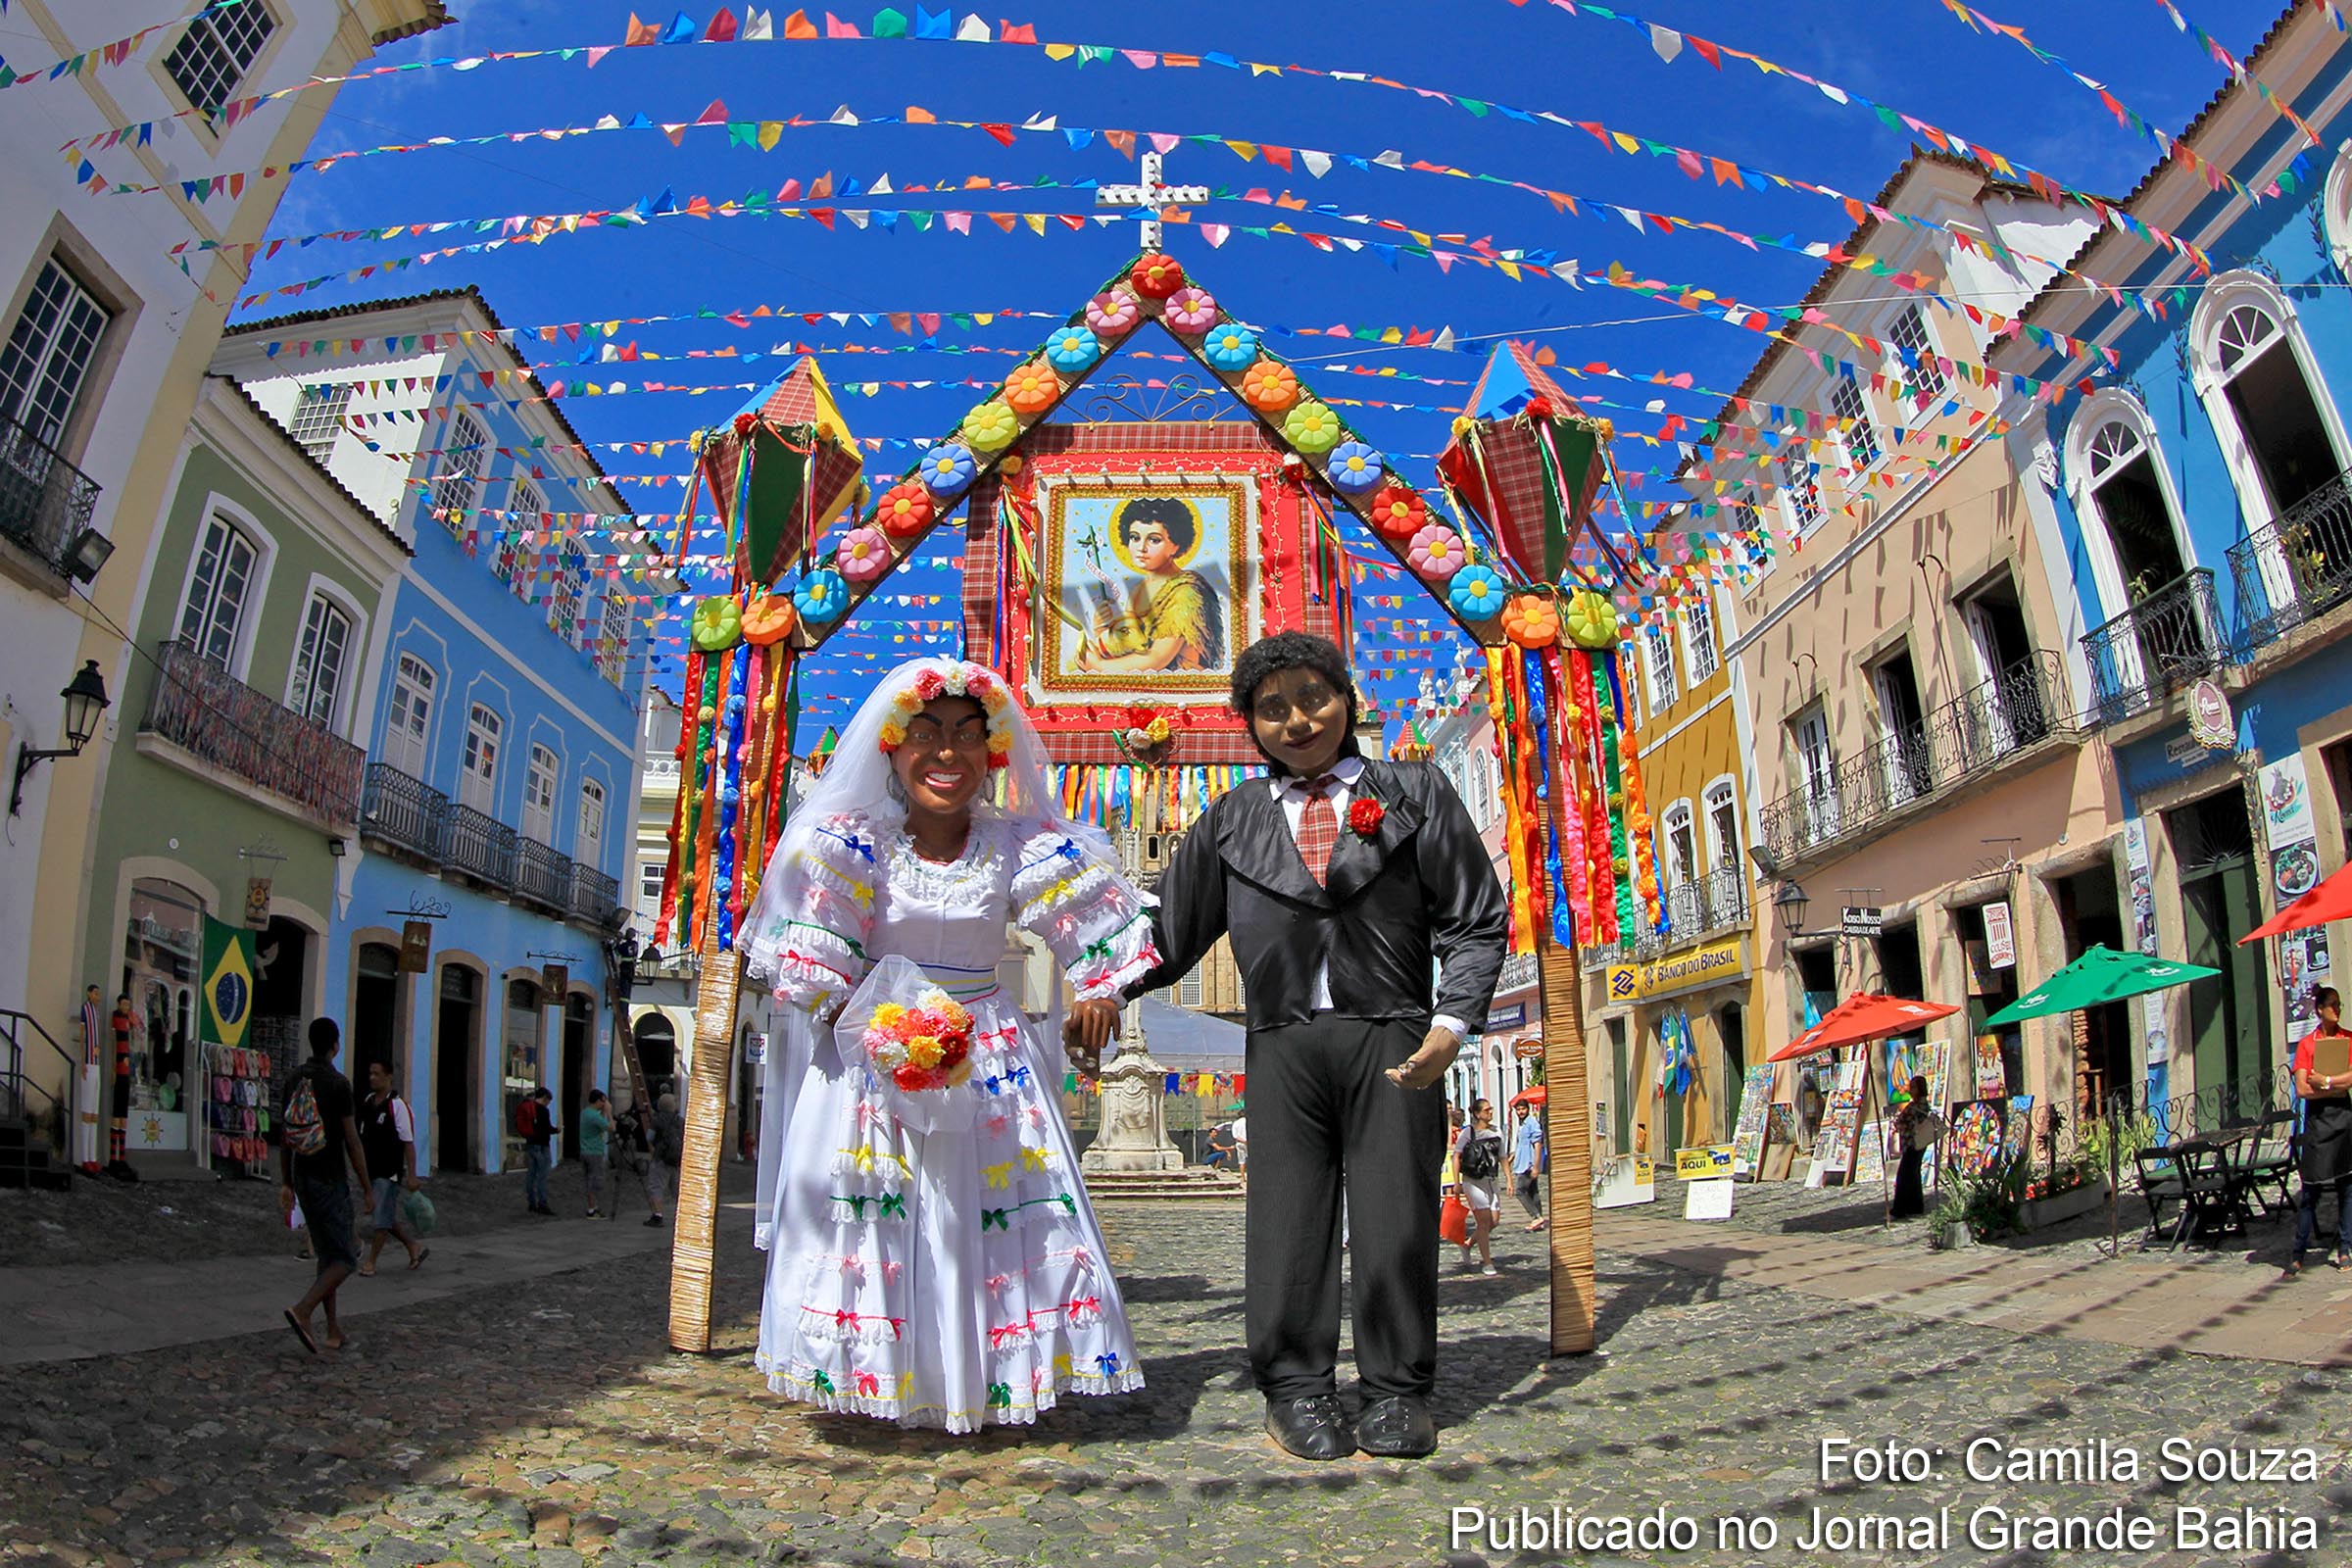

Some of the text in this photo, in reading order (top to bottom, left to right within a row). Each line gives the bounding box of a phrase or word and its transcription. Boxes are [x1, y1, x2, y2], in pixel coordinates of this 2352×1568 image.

[1842, 907, 1860, 923] Kasa
[1657, 949, 1735, 982] BANCO DO BRASIL
[1681, 1159, 1706, 1170] AQUI
